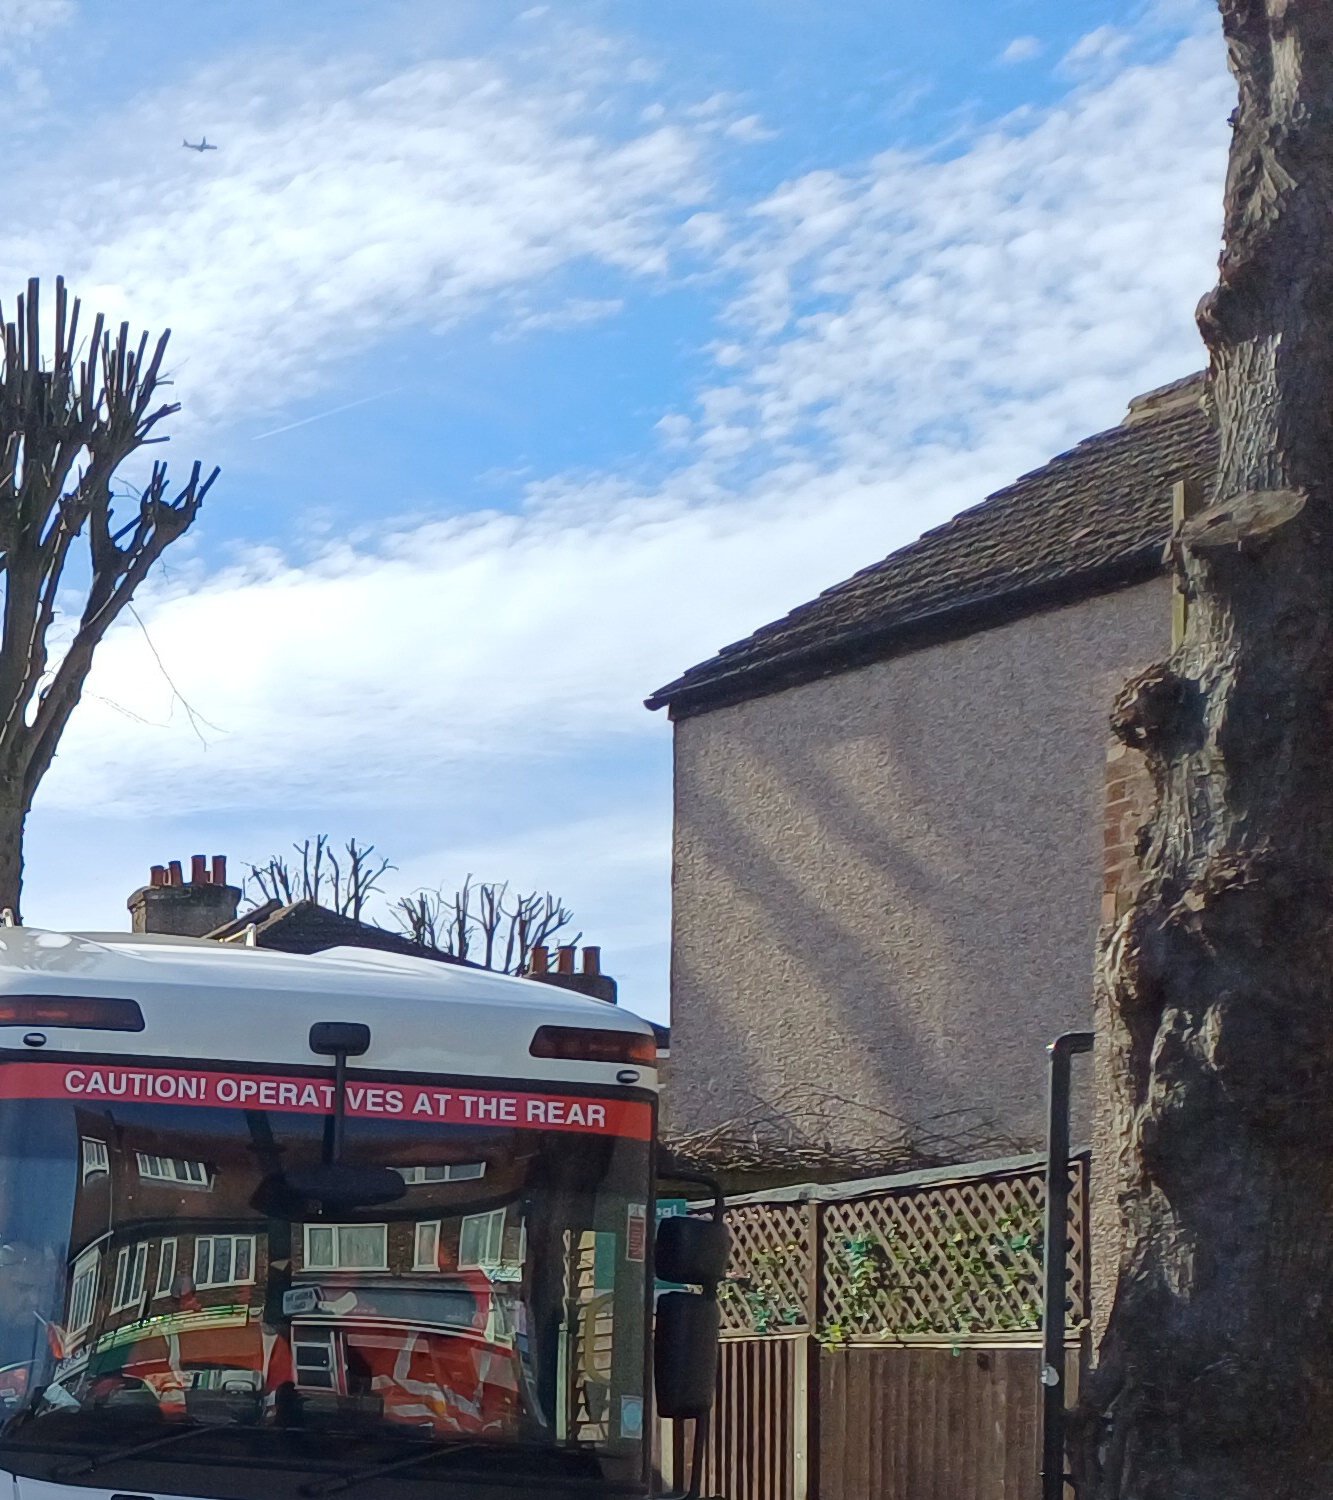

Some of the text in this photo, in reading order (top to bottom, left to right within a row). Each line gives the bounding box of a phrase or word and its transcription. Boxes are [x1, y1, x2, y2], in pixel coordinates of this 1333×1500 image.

[65, 1070, 606, 1128] CAUTION! OPERATVES AT THE REAR
